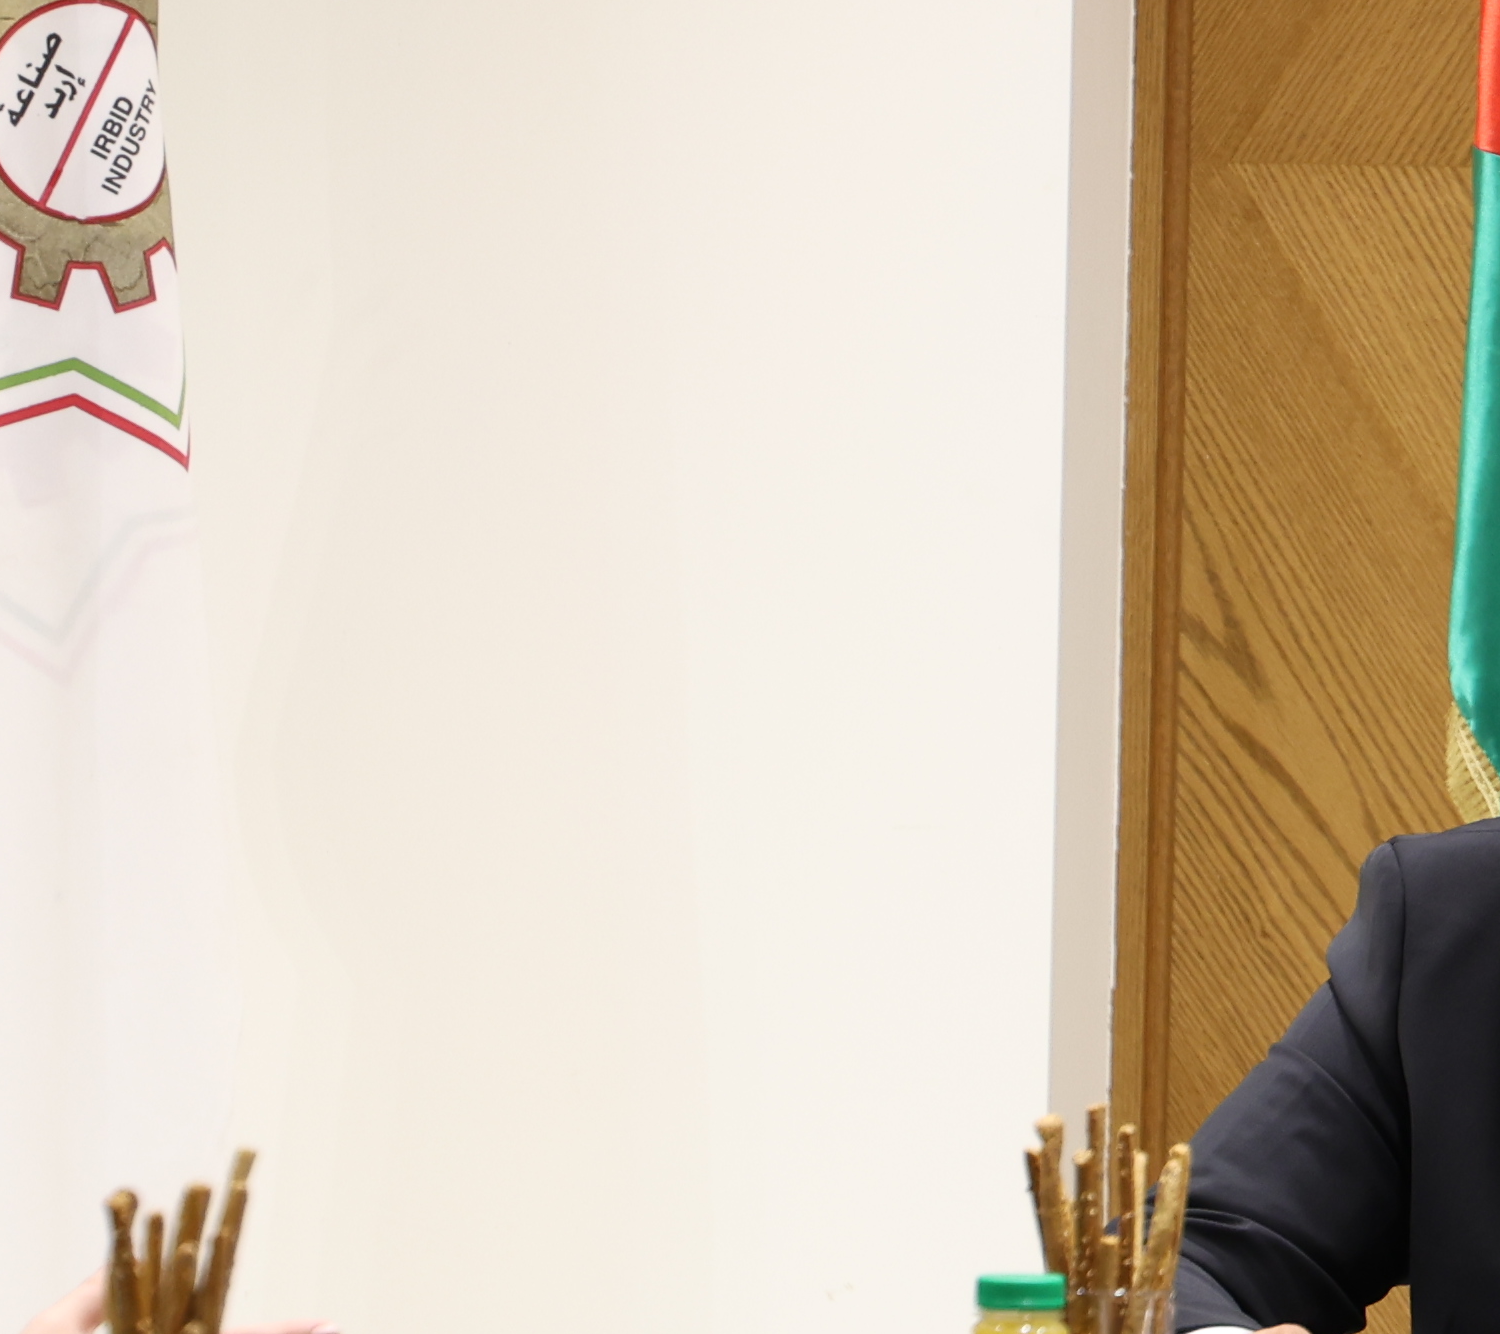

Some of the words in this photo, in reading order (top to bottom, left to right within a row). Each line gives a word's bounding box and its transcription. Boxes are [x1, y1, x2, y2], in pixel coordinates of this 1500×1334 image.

[44, 64, 86, 119] إربد
[89, 96, 134, 161] IRBID
[101, 79, 158, 196] INDUSTRY
